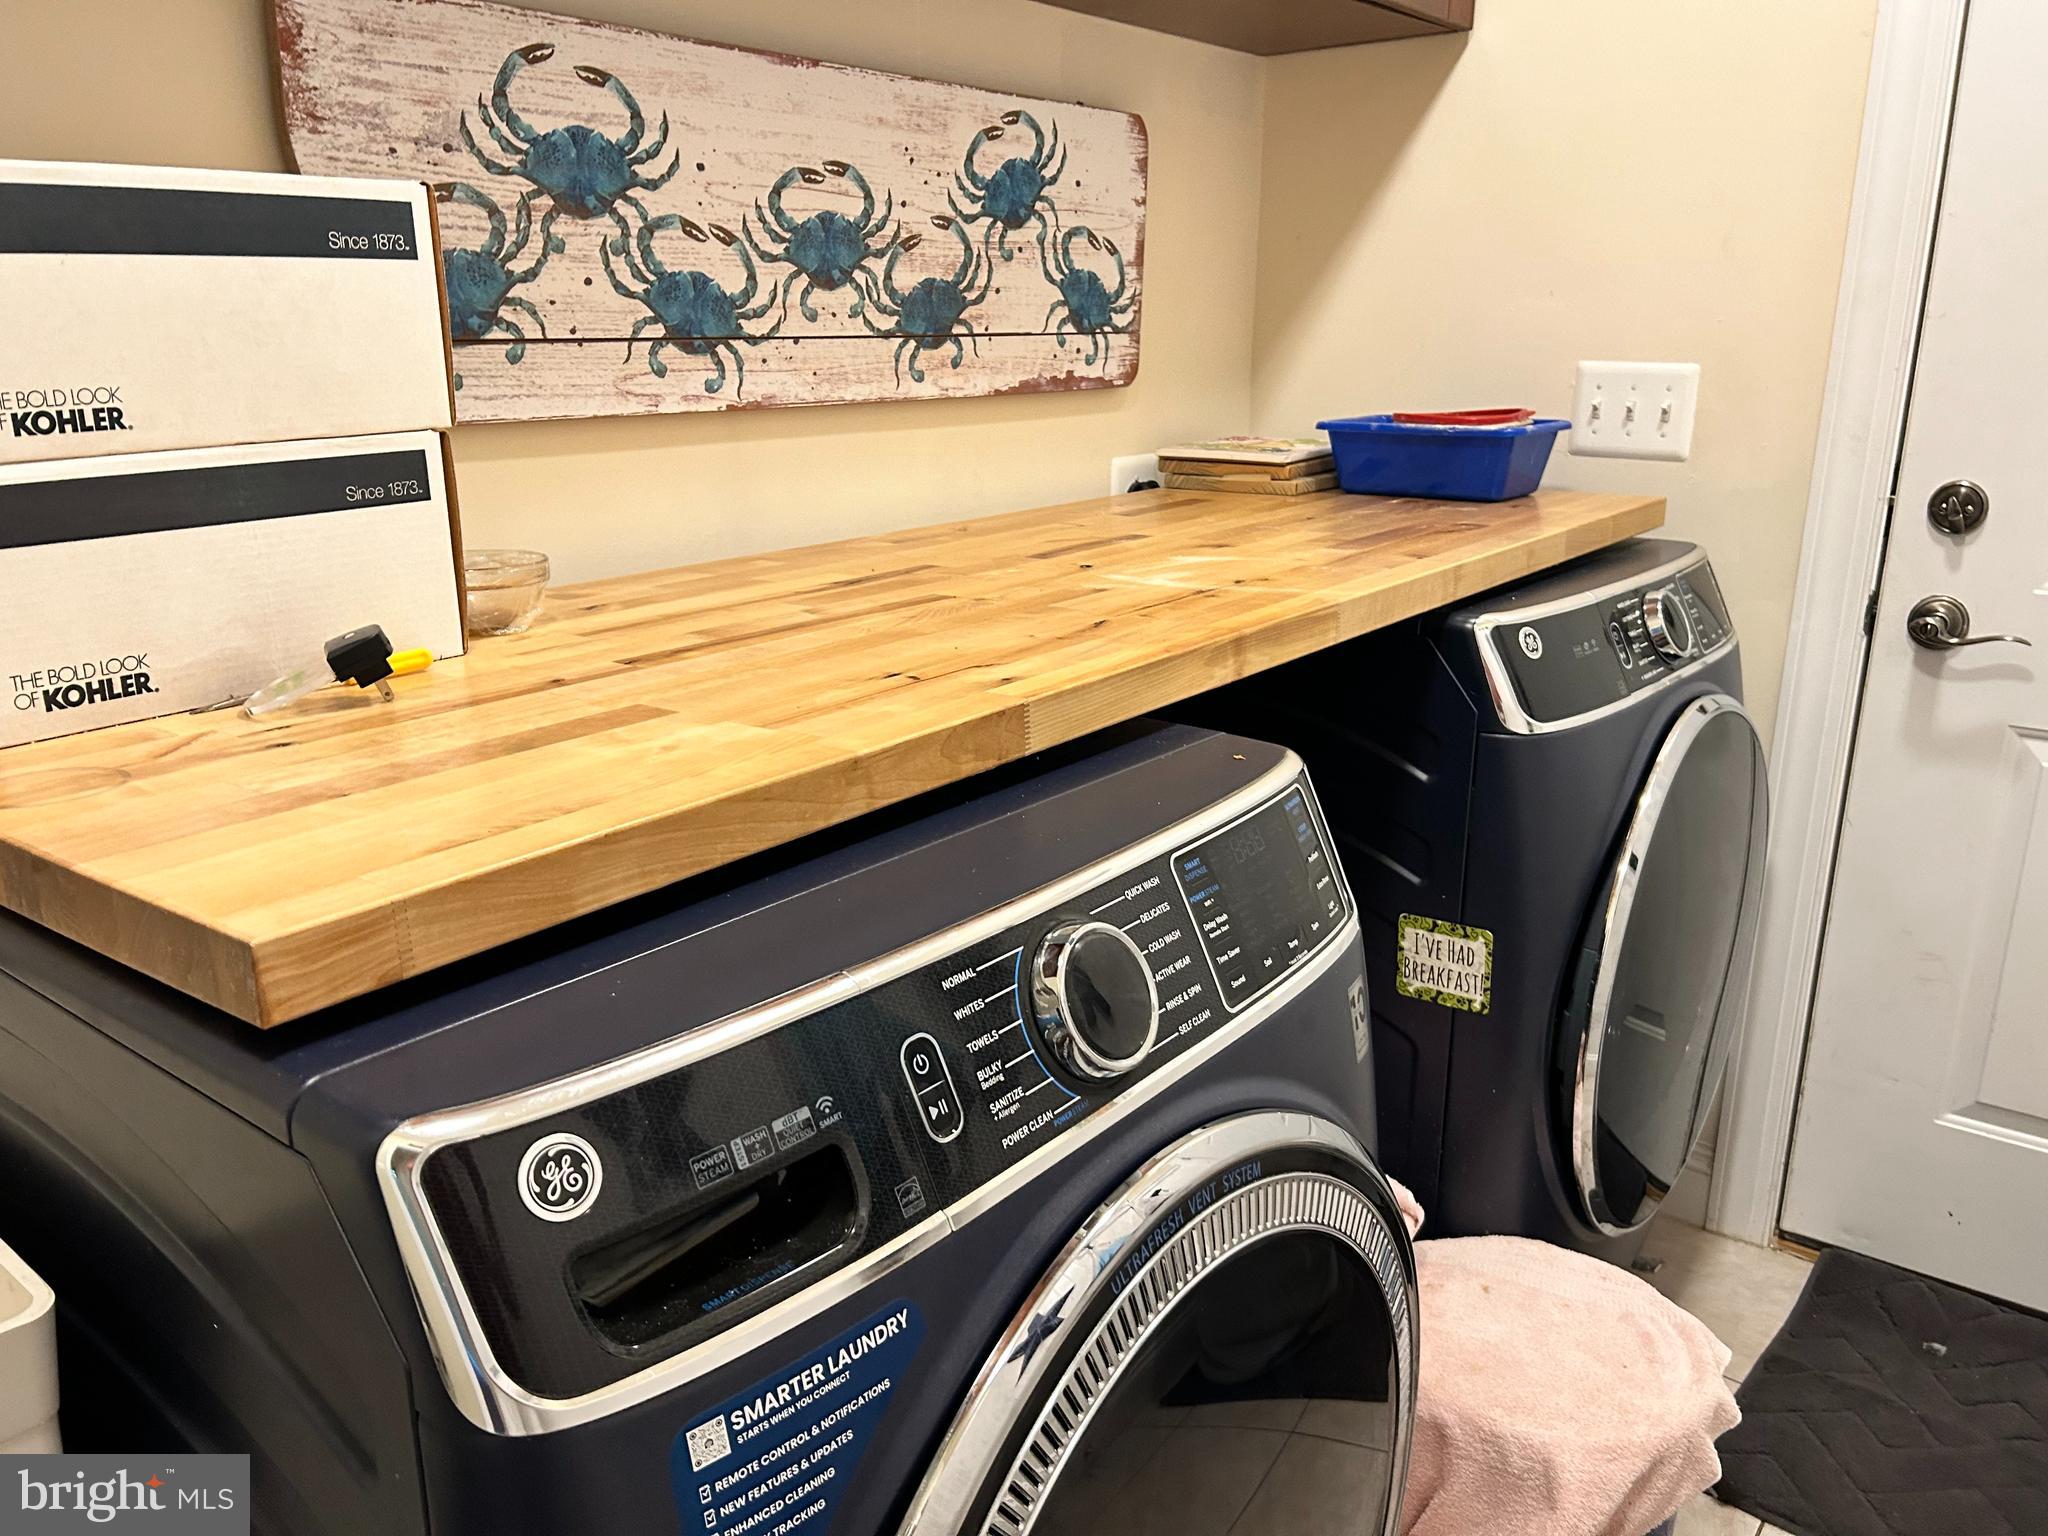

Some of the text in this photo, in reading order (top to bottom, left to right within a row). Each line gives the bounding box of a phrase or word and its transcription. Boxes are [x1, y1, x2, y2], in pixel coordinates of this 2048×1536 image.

[328, 231, 369, 249] Since
[15, 388, 67, 409] BOLD
[70, 386, 123, 406] LOOK
[0, 412, 7, 431] F
[345, 485, 384, 502] Since
[9, 652, 151, 692] THE BOLD LOOK
[13, 691, 39, 711] OF
[1183, 857, 1201, 871] SMART
[1124, 876, 1160, 901] QUICK WASH
[1139, 901, 1171, 924] DELICATES
[1148, 929, 1182, 953] COLD WASH
[1414, 932, 1475, 967] I'VE HAD
[941, 967, 977, 991] NORMAL
[1154, 955, 1192, 983] ACTIVE WEAR
[1403, 956, 1485, 997] BREAKFAST!
[1165, 983, 1202, 1011] RINSE & SPIN
[953, 998, 985, 1021] WHITES
[1178, 1008, 1211, 1035] SELF CLEAN
[965, 1029, 999, 1054] TOWELS
[976, 1059, 1004, 1082] BULKY
[981, 1072, 1005, 1091] Bedding
[989, 1086, 1025, 1114] SANITIZE
[998, 1101, 1021, 1121] Allergen
[782, 1112, 799, 1127] dBT
[819, 1111, 844, 1129] SMART
[1001, 1110, 1055, 1150] POWER CLEAN
[742, 1129, 767, 1147] WASH
[780, 1127, 814, 1148] CONTROL
[693, 1151, 727, 1173] POWER
[751, 1149, 768, 1161] DRY
[698, 1162, 730, 1183] STEAM
[1111, 1160, 1262, 1296] ULTRAFRESH VENT SYSTEM
[730, 1308, 909, 1431] SMARTER LAUNDRY
[736, 1371, 850, 1444] STARTS WHEN YOU CONNECT
[715, 1378, 891, 1493] REMOTE CONTROL & NOTIFICATIONS
[719, 1429, 854, 1517] NEW FEATURES & UPDATES
[785, 1467, 836, 1505] CLEANING
[772, 1498, 827, 1536] TRACKING
